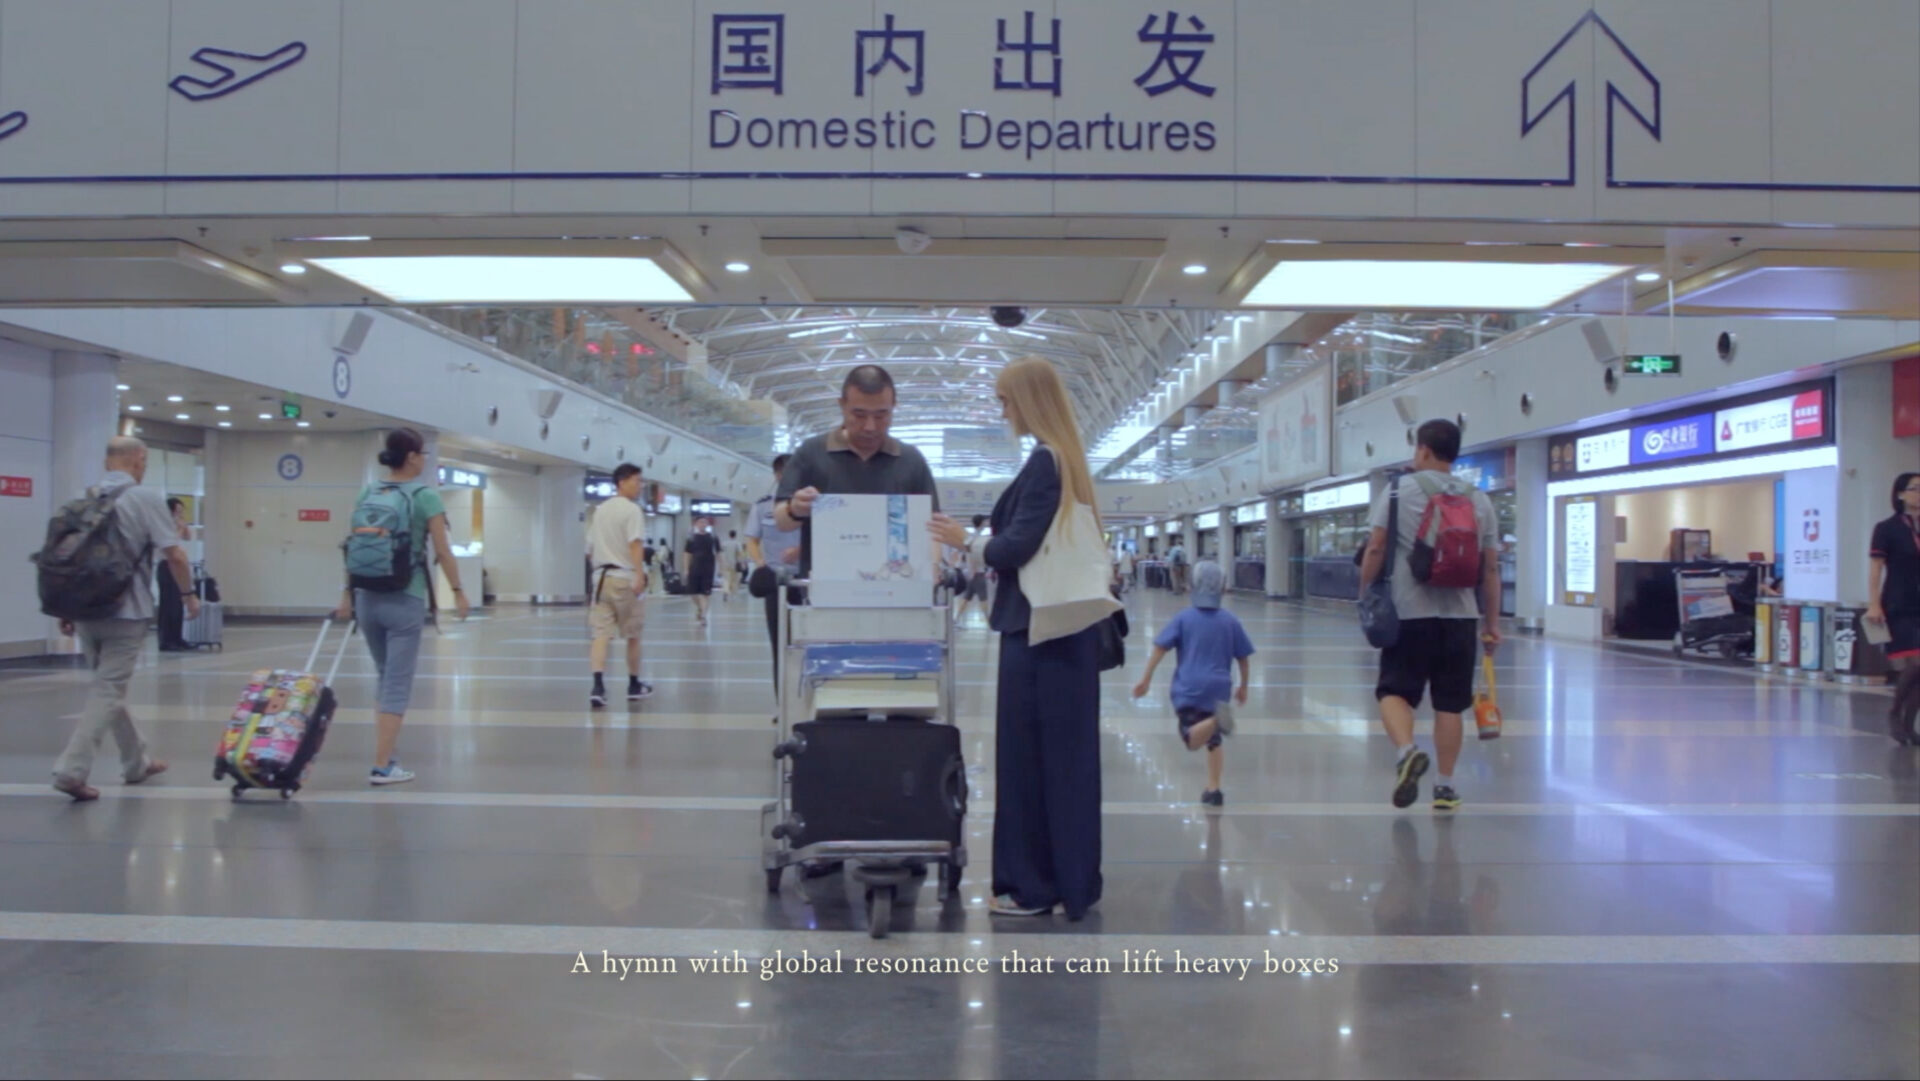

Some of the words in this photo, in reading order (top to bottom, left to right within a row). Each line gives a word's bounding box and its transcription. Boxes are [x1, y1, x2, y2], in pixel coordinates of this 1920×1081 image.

[710, 11, 1217, 97] 国内出发
[710, 110, 935, 149] Domestic
[961, 109, 1217, 161] Departures
[335, 361, 348, 393] 8
[281, 458, 299, 478] 8
